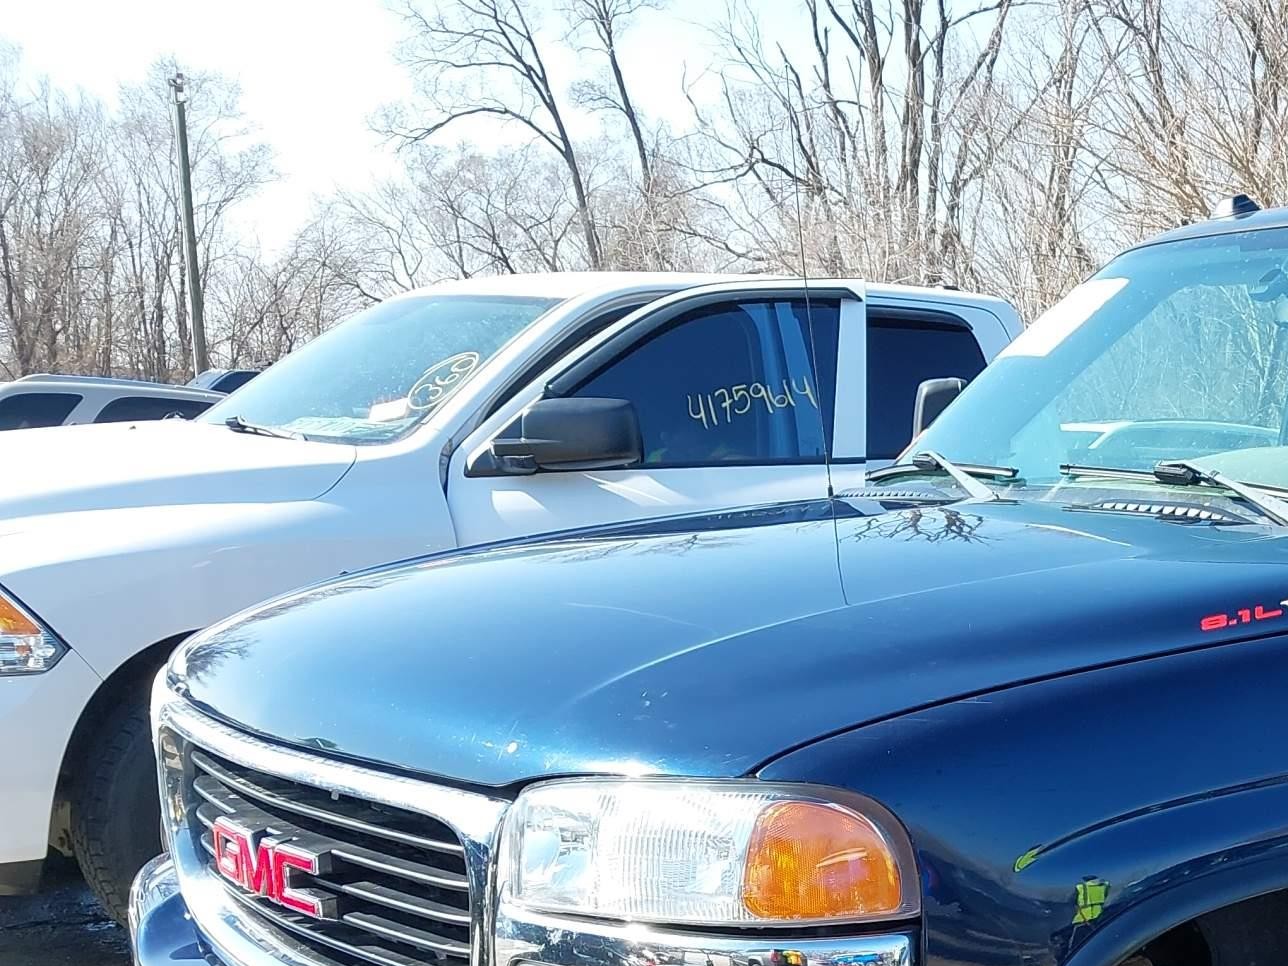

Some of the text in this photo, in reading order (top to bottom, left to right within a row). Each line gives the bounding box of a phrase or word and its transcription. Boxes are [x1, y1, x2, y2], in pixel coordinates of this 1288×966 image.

[414, 357, 476, 400] 360
[687, 375, 818, 430] 41759614
[213, 816, 324, 919] GMC
